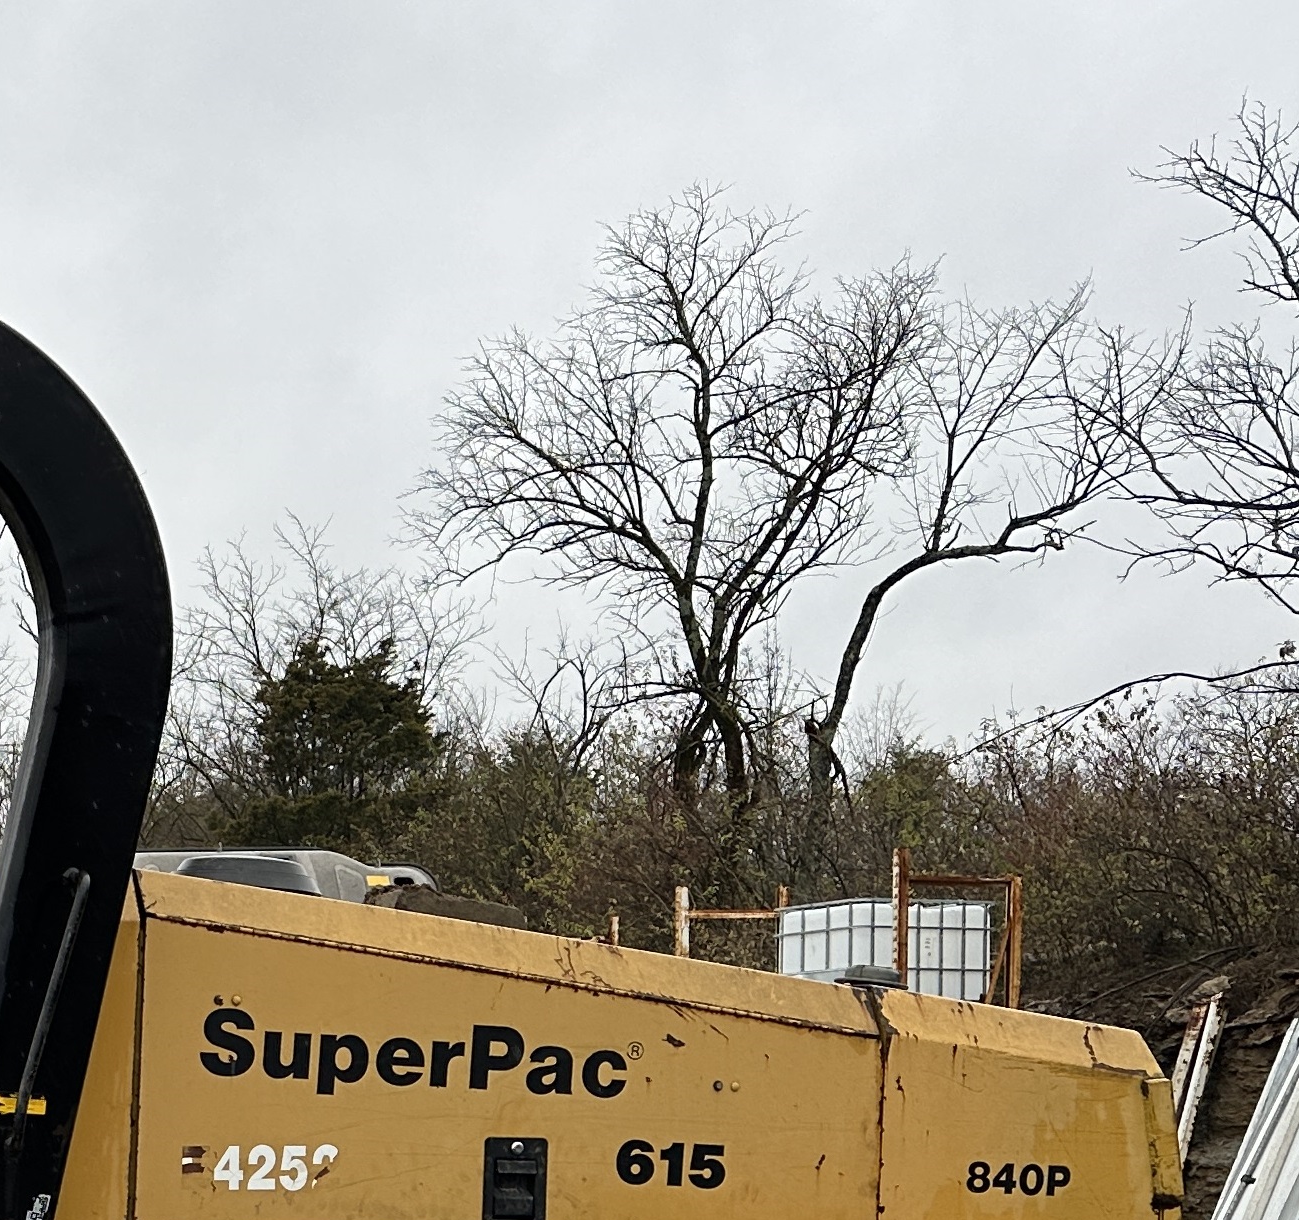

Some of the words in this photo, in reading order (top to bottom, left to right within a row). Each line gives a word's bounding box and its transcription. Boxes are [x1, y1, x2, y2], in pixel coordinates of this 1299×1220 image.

[199, 1008, 629, 1099] SuperPac
[615, 1139, 726, 1190] 615
[966, 1161, 1072, 1197] 840P
